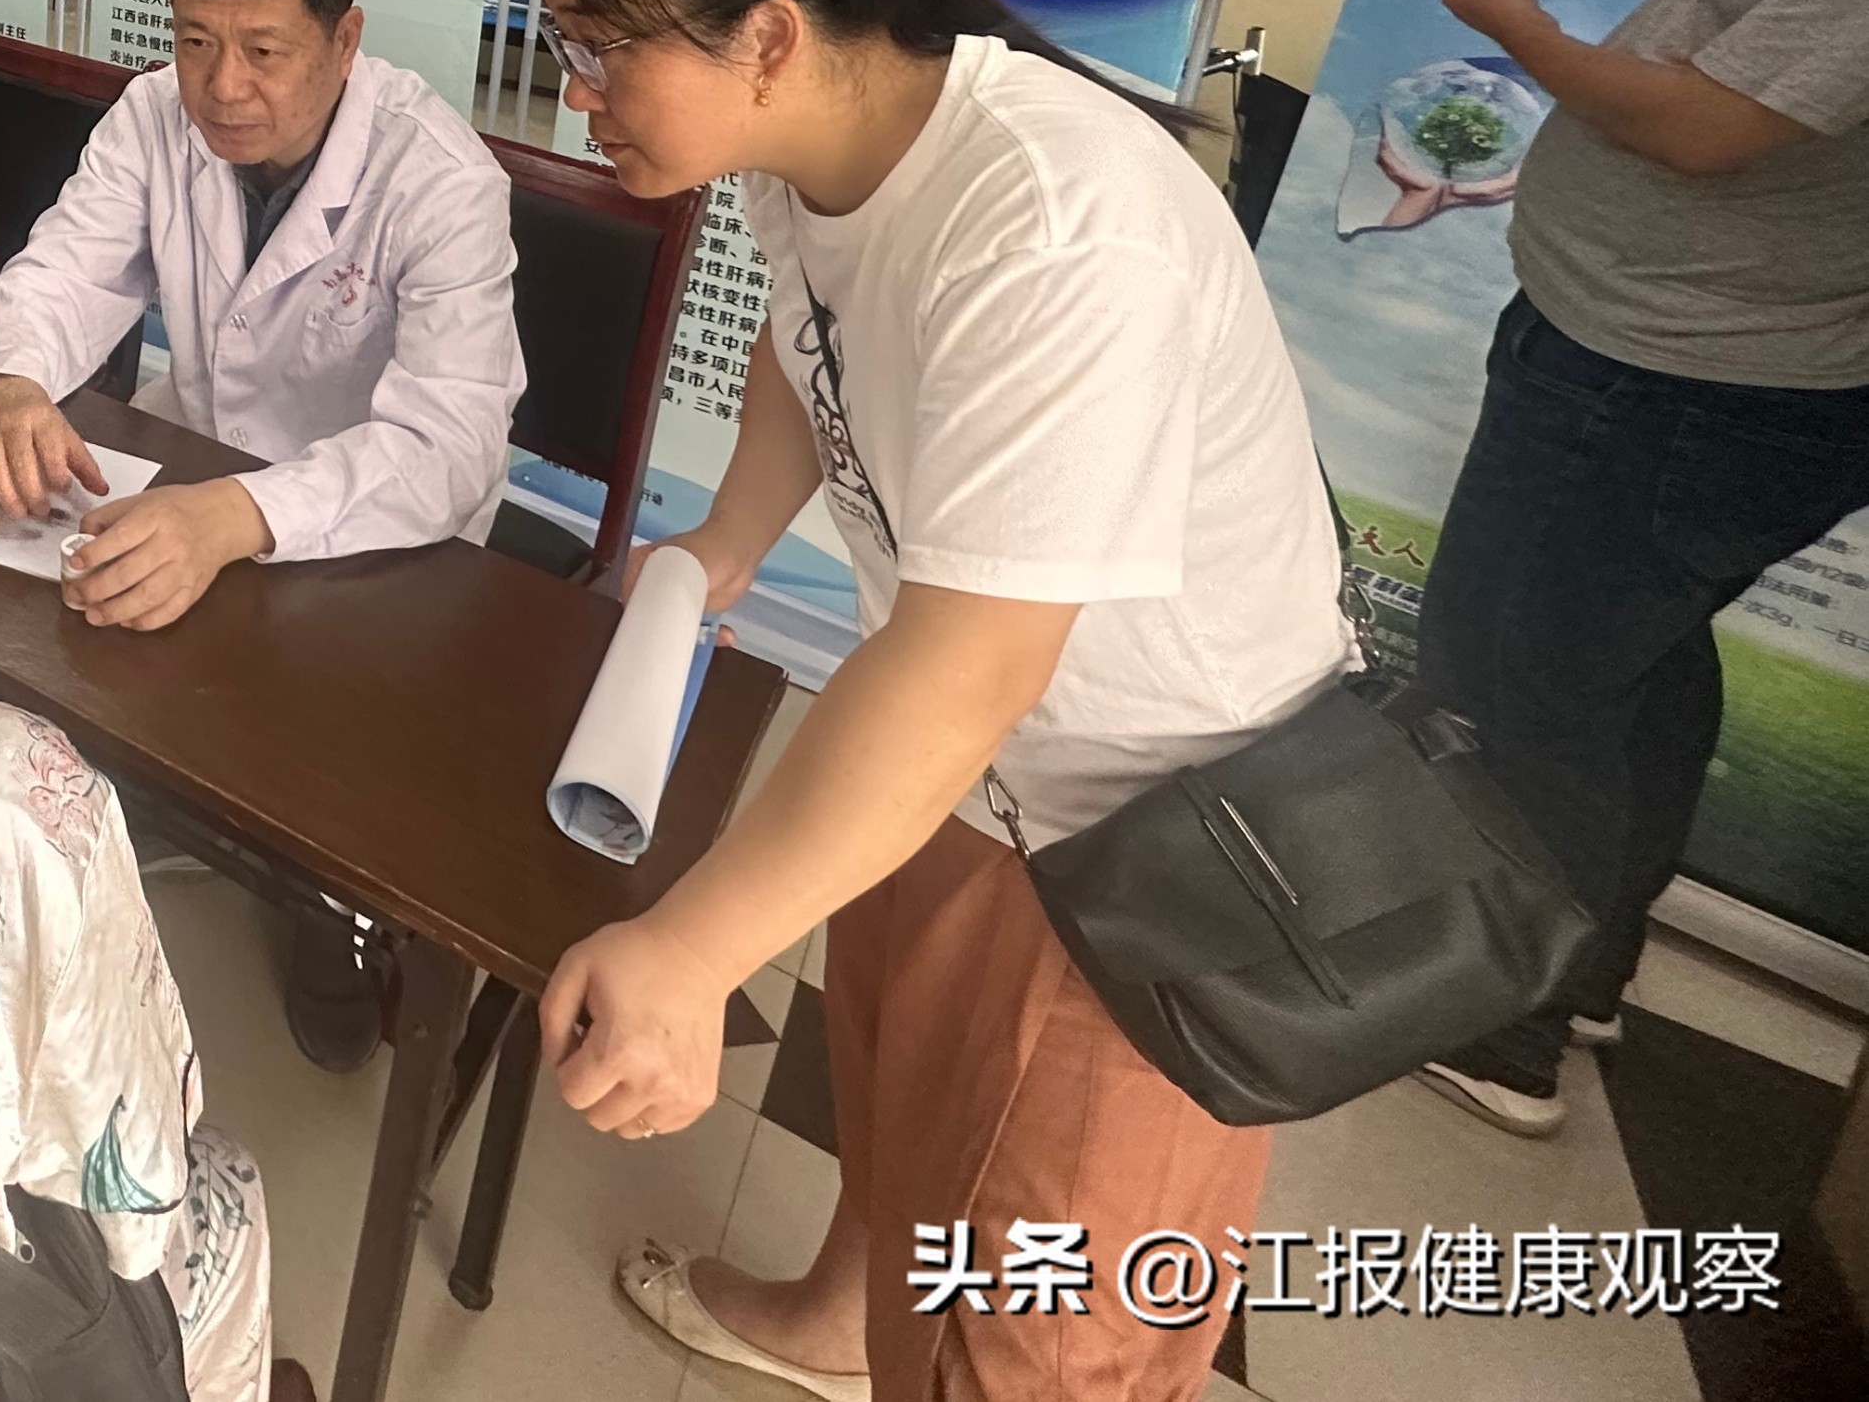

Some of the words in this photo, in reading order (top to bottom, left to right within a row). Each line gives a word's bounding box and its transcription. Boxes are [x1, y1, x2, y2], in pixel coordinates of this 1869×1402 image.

[110, 49, 147, 70] 炎治疗
[686, 278, 770, 312] 核变性
[669, 365, 744, 401] 昌市人民
